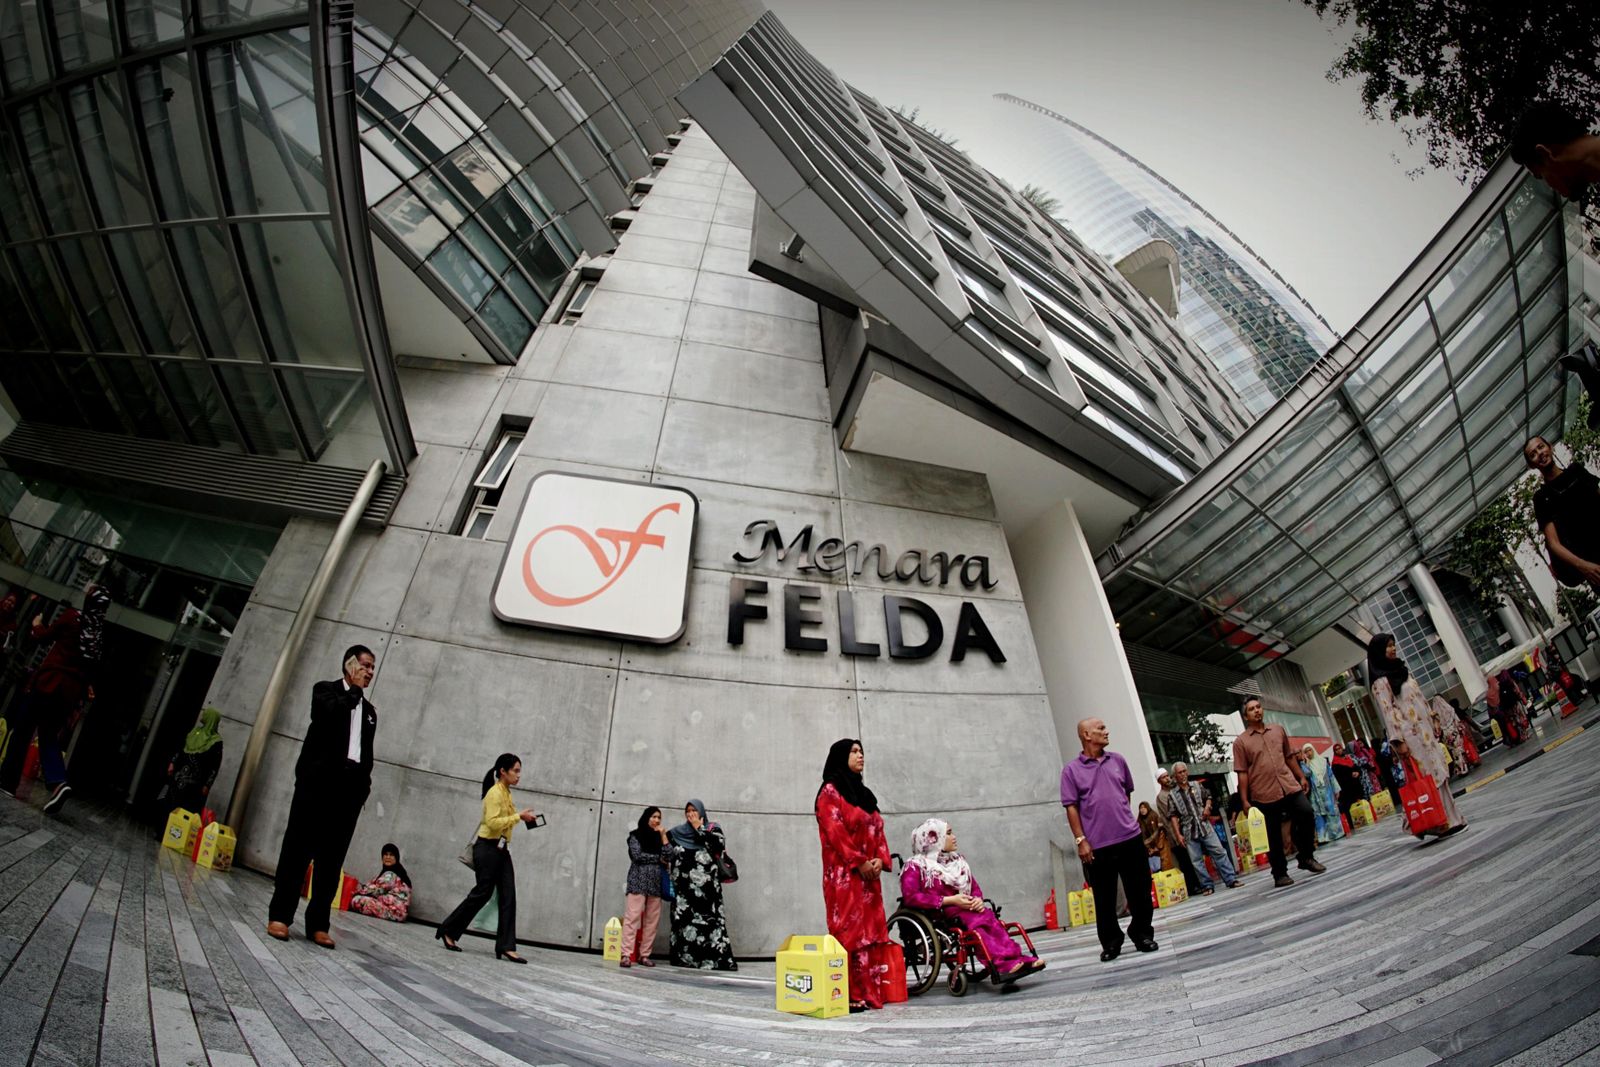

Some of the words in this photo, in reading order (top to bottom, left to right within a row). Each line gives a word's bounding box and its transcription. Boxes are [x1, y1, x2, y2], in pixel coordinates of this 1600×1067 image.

[733, 519, 998, 591] Menara
[727, 577, 1008, 664] FELDA
[786, 974, 811, 993] Saji
